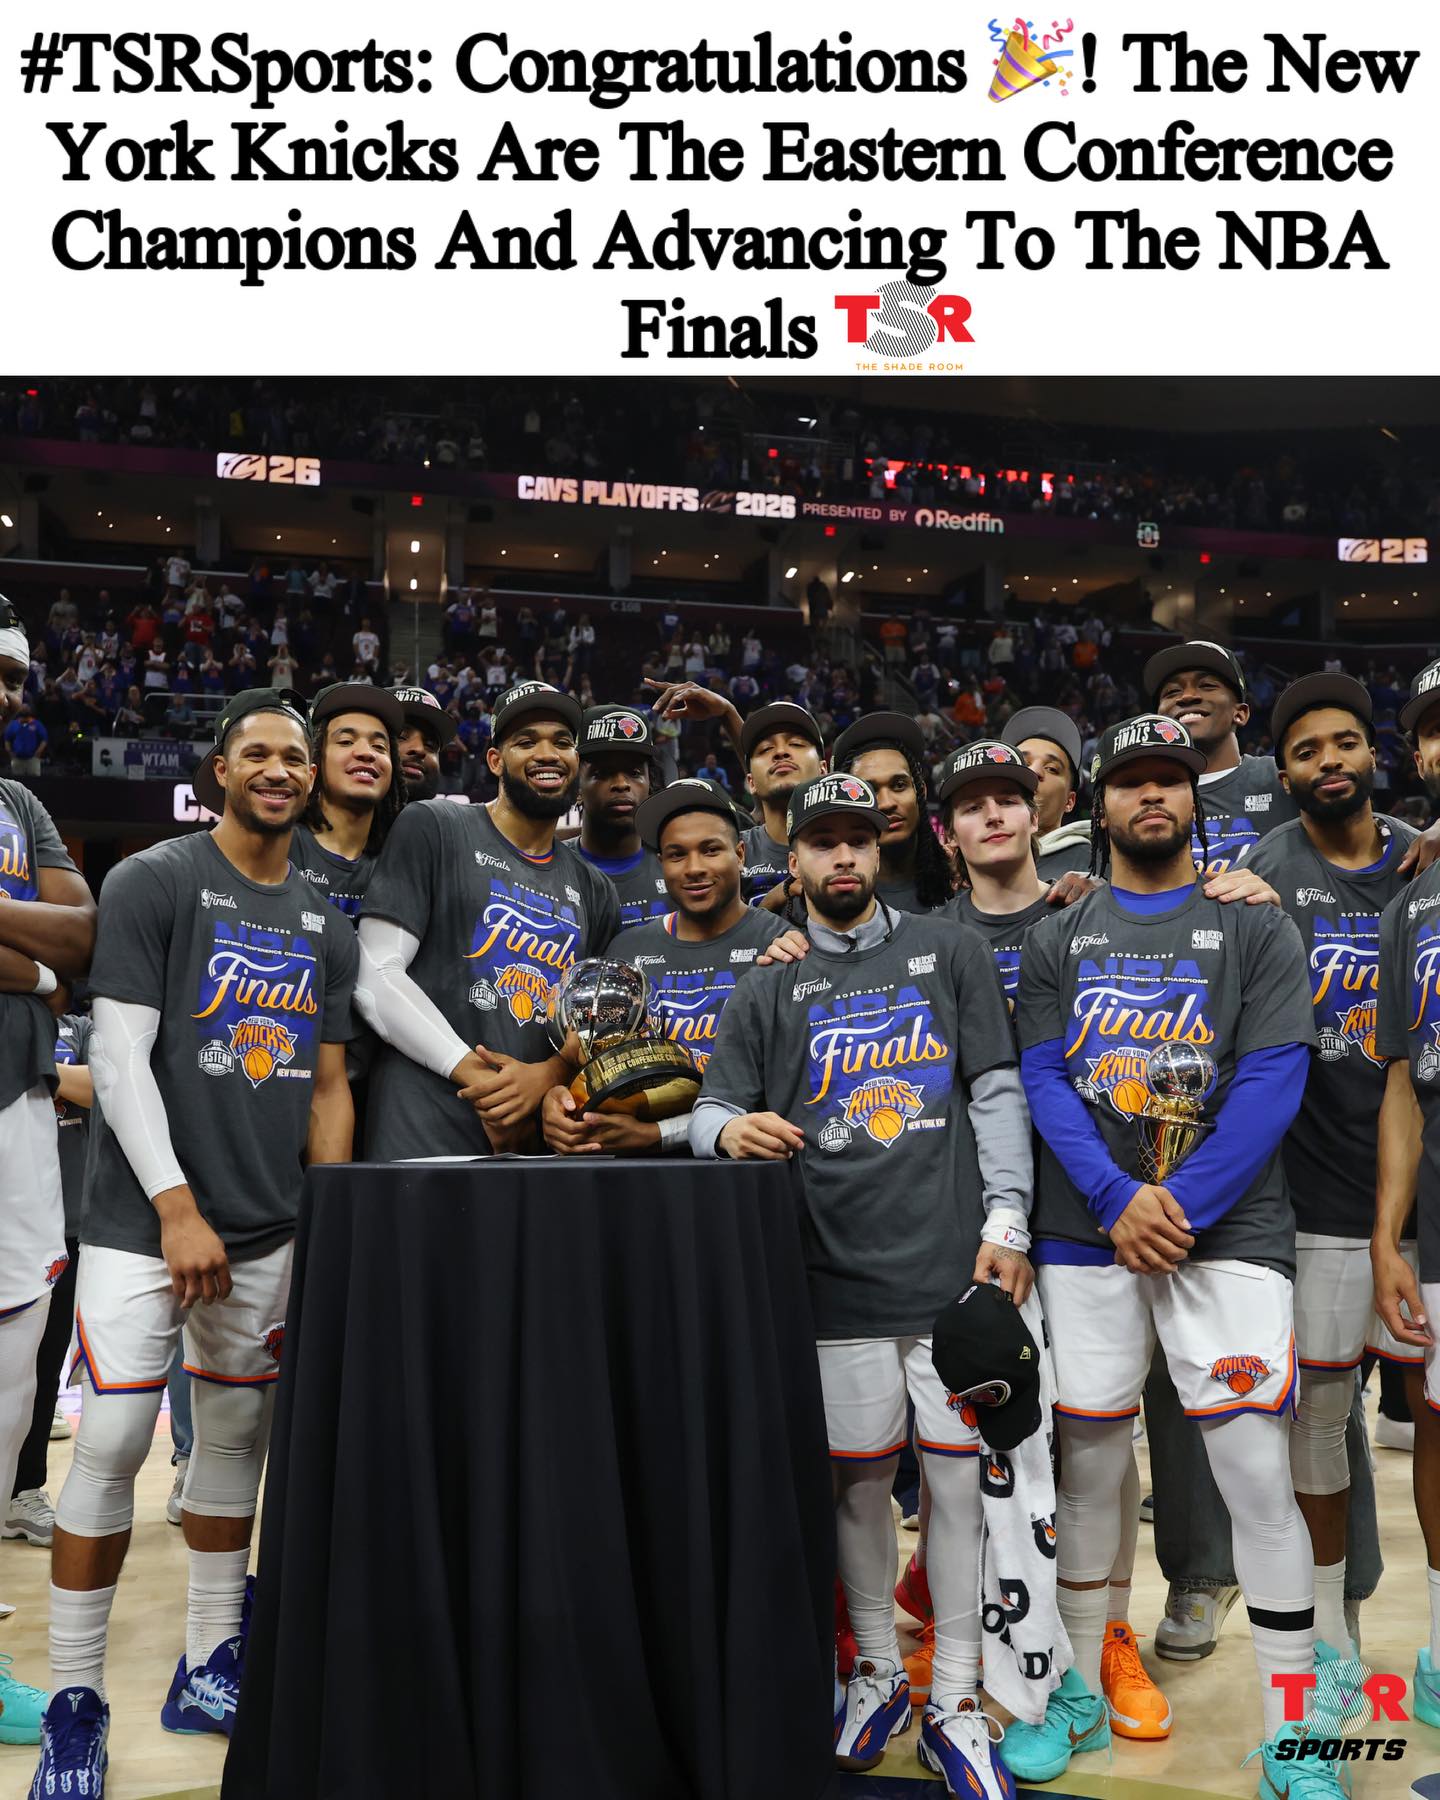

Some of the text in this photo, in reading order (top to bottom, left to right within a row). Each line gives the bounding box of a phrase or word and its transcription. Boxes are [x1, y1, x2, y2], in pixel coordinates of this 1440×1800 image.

[518, 475, 797, 519] CAVS PLAYOFFS 2026
[802, 503, 907, 521] PRESENTED BY
[935, 510, 1004, 533] Redfin
[587, 722, 616, 740] FINALS
[1113, 727, 1150, 754] FINALS
[142, 753, 180, 767] WTAM
[953, 753, 984, 773] FINALS
[804, 785, 838, 810] FINALS
[208, 893, 238, 911] Finals
[214, 938, 242, 948] EASTERN
[243, 943, 282, 955] CONFERENCE
[463, 903, 576, 971] Finals
[191, 951, 318, 1018] Finals
[497, 967, 549, 1003] KNICKS
[799, 977, 832, 1002] Finals
[1078, 974, 1208, 984] EASTERN CONFERENCE CHAMPIONS
[471, 987, 496, 1005] EASTERN
[835, 984, 895, 1000] 2025-2026
[810, 1000, 931, 1027] EASTERN CONFERENCE CHAMPIONS
[1065, 987, 1215, 1059] Finals
[1343, 1008, 1377, 1034] KNI
[231, 1023, 293, 1056] KNICKS
[1320, 1038, 1346, 1051] STERN
[200, 1050, 233, 1069] EASTERN
[804, 1015, 948, 1105] Finals
[864, 1078, 895, 1089] NEW YORK
[847, 1082, 921, 1120] KNICKS
[820, 1127, 849, 1143] EASTERN
[1212, 1355, 1270, 1378] KNICKS
